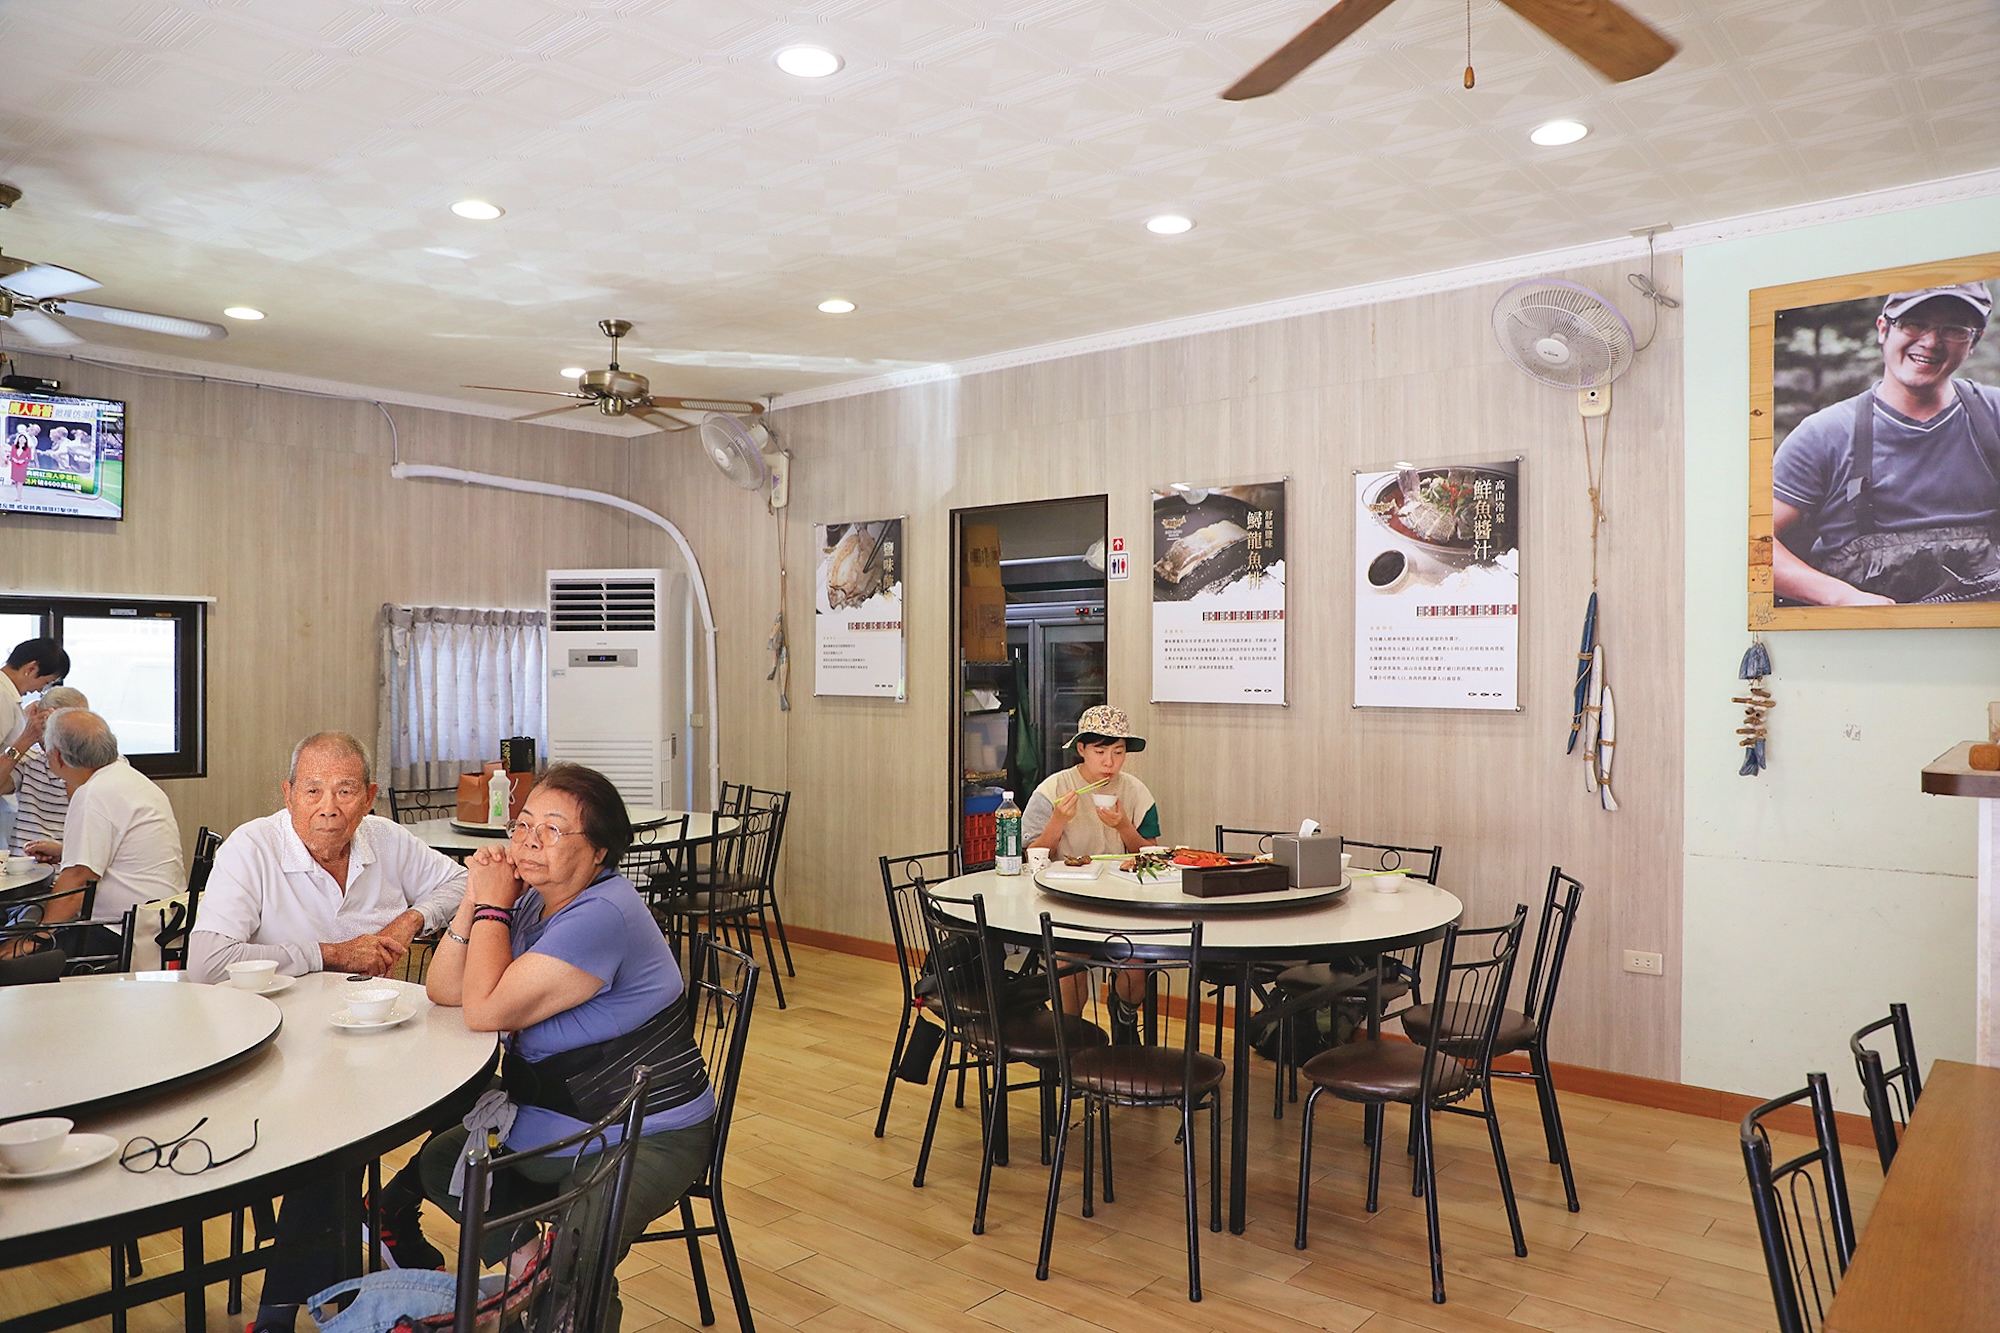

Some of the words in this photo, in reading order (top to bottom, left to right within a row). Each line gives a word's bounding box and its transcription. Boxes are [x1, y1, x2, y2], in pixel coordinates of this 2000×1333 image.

[1473, 479, 1492, 561] 鮮魚醬汁
[1495, 479, 1506, 523] 高山冷泉
